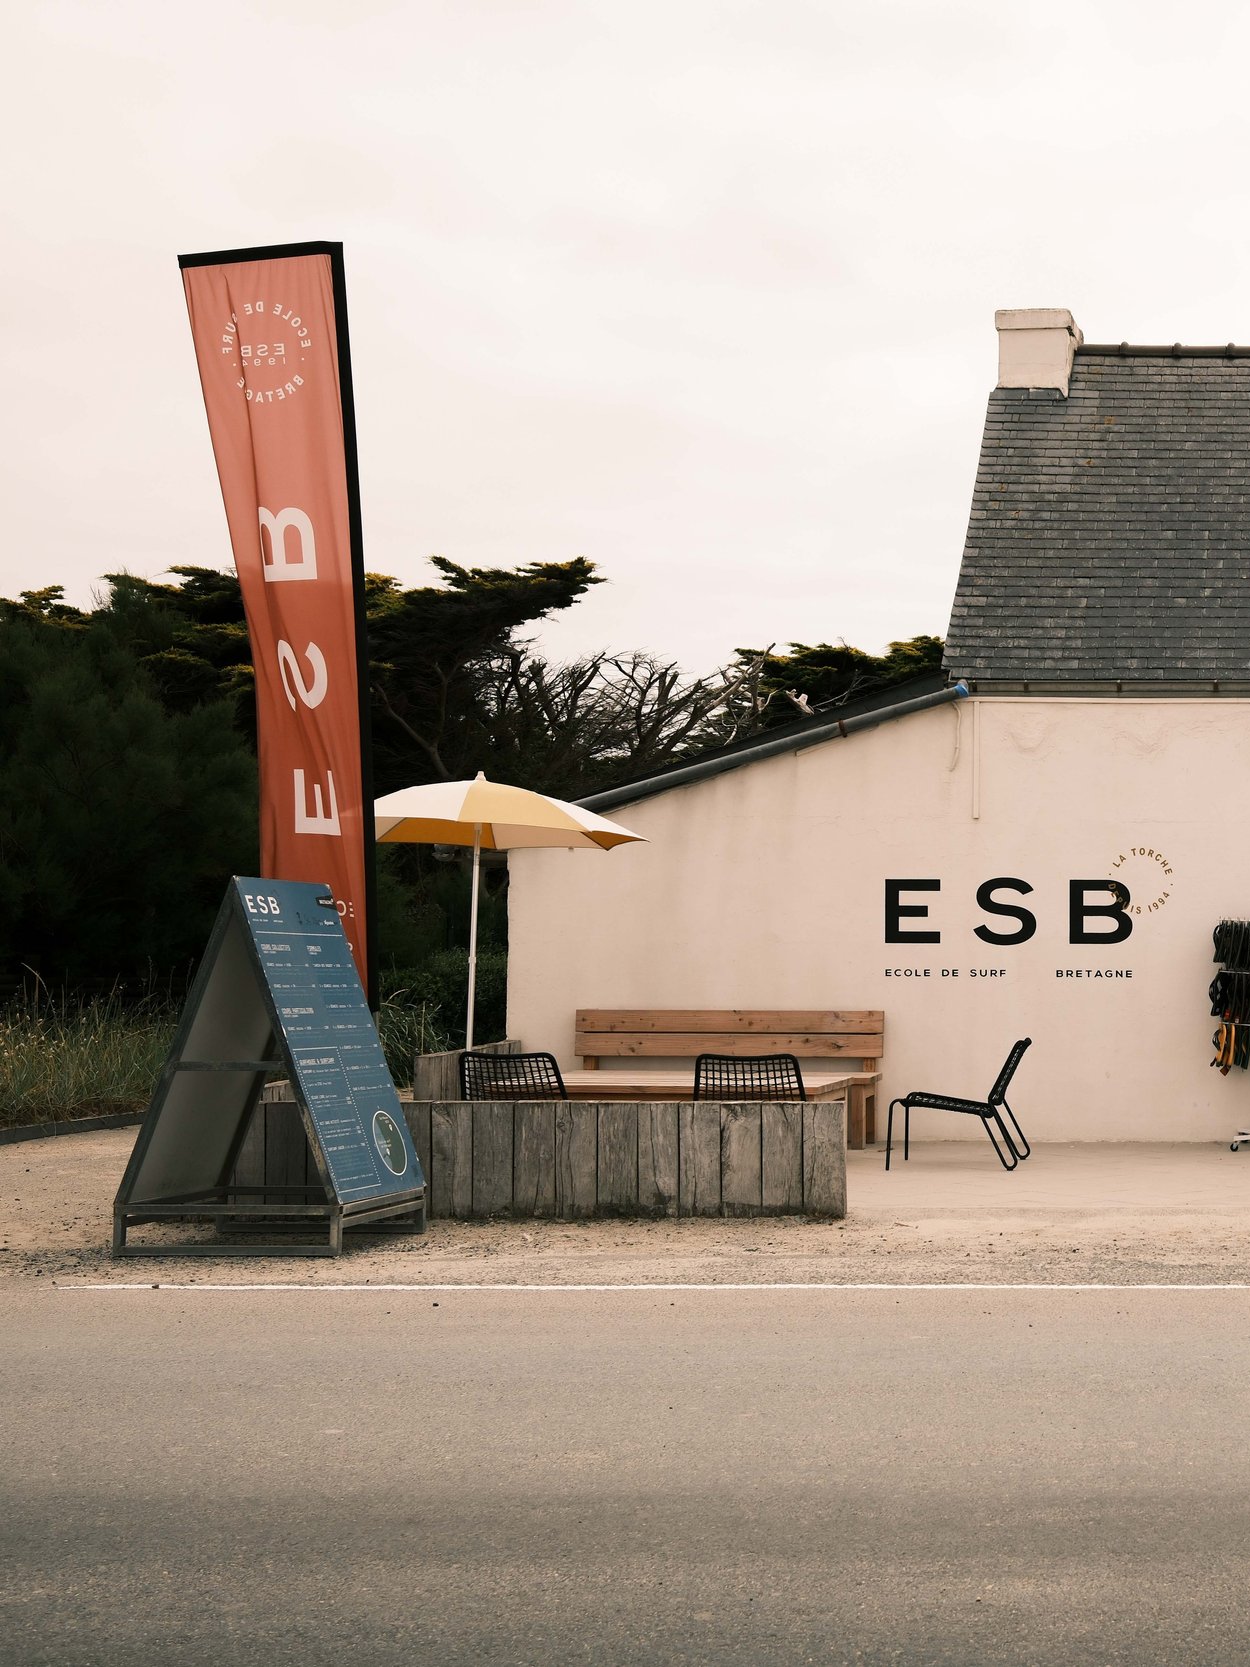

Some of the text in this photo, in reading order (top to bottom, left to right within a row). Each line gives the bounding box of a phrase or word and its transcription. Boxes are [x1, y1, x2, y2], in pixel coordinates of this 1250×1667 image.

[1112, 847, 1173, 875] LA TORCHE
[244, 894, 280, 916] ESB
[885, 877, 1133, 946] ESB
[1108, 883, 1170, 914] DEPUIS 1994
[885, 968, 1133, 978] ECOLE DE SURF BRETAGNE
